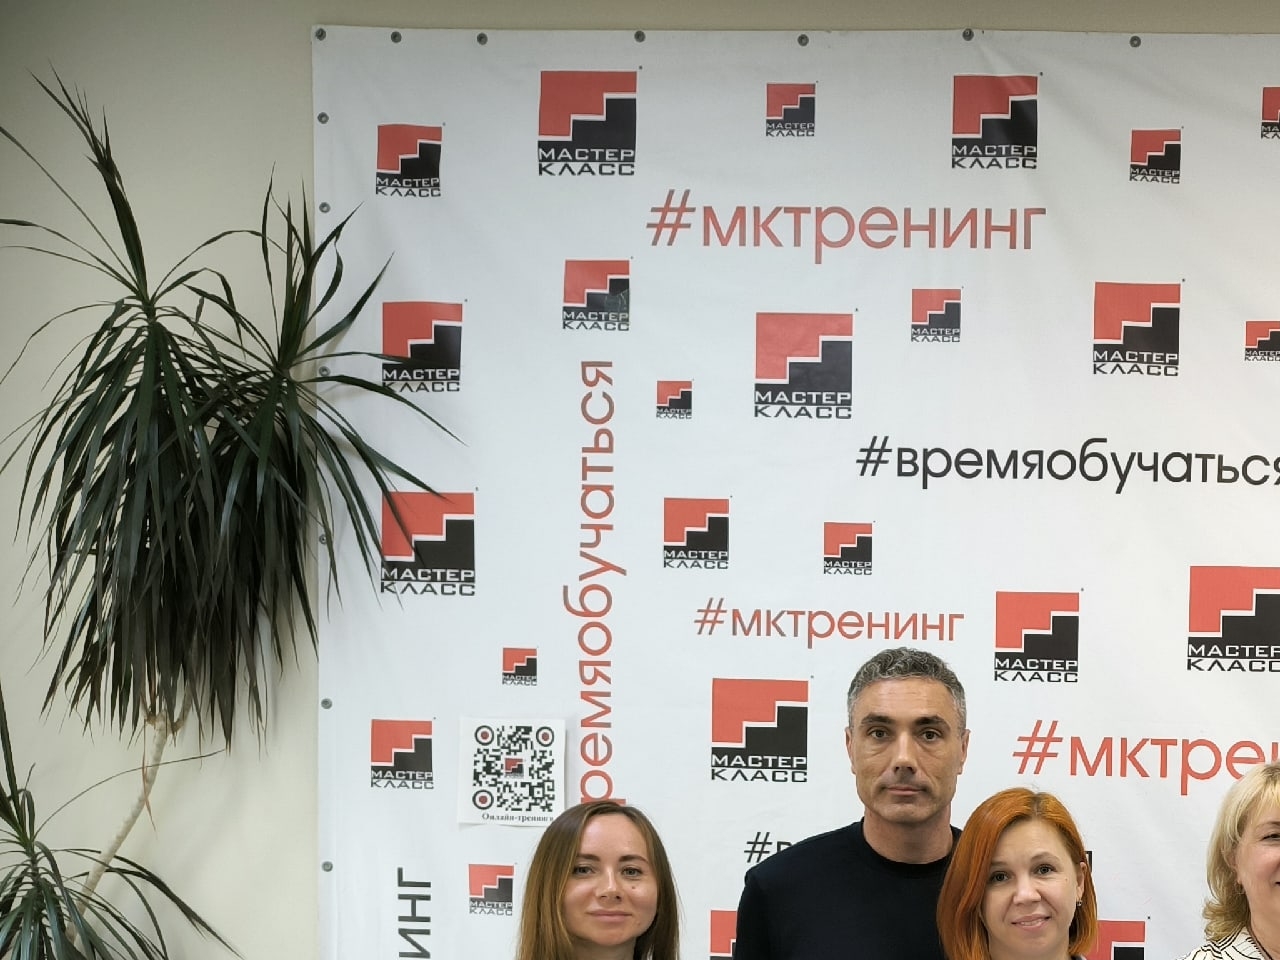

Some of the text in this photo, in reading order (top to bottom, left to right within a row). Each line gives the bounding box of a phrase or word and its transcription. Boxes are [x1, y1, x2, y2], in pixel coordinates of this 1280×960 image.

[539, 150, 634, 162] МАСТЕР
[952, 146, 1037, 158] МАСТЕР
[539, 163, 634, 175] КЛАСС
[952, 158, 1037, 169] КЛАСС
[1130, 169, 1179, 177] МАСТЕР
[376, 178, 440, 188] МАСТЕР
[376, 188, 440, 197] КЛАСС
[647, 189, 1046, 263] #мктренинг
[563, 314, 629, 322] МАСТЕР
[563, 322, 629, 331] КЛАСС
[911, 328, 960, 336] МАСТЕР
[1094, 353, 1178, 364] МАСТЕР
[383, 369, 460, 380] МАСТЕР
[1094, 365, 1178, 376] КЛАСС
[755, 393, 851, 406] МАСТЕР
[755, 406, 851, 419] КЛАСС
[664, 552, 728, 560] МАСТЕР
[664, 560, 728, 569] КЛАСС
[381, 567, 475, 581] МАСТЕР
[381, 582, 475, 596] КЛАСС
[563, 361, 627, 806] ремяобучаться
[694, 597, 964, 649] #мктренинг
[995, 660, 1077, 671] МАСТЕР
[995, 671, 1077, 682] КЛАСС
[712, 756, 807, 769] МАСТЕР
[371, 772, 433, 780] МАСТЕР
[712, 770, 807, 782] КЛАСС
[371, 781, 433, 789] КЛАСС
[470, 901, 512, 909] МАСТЕР
